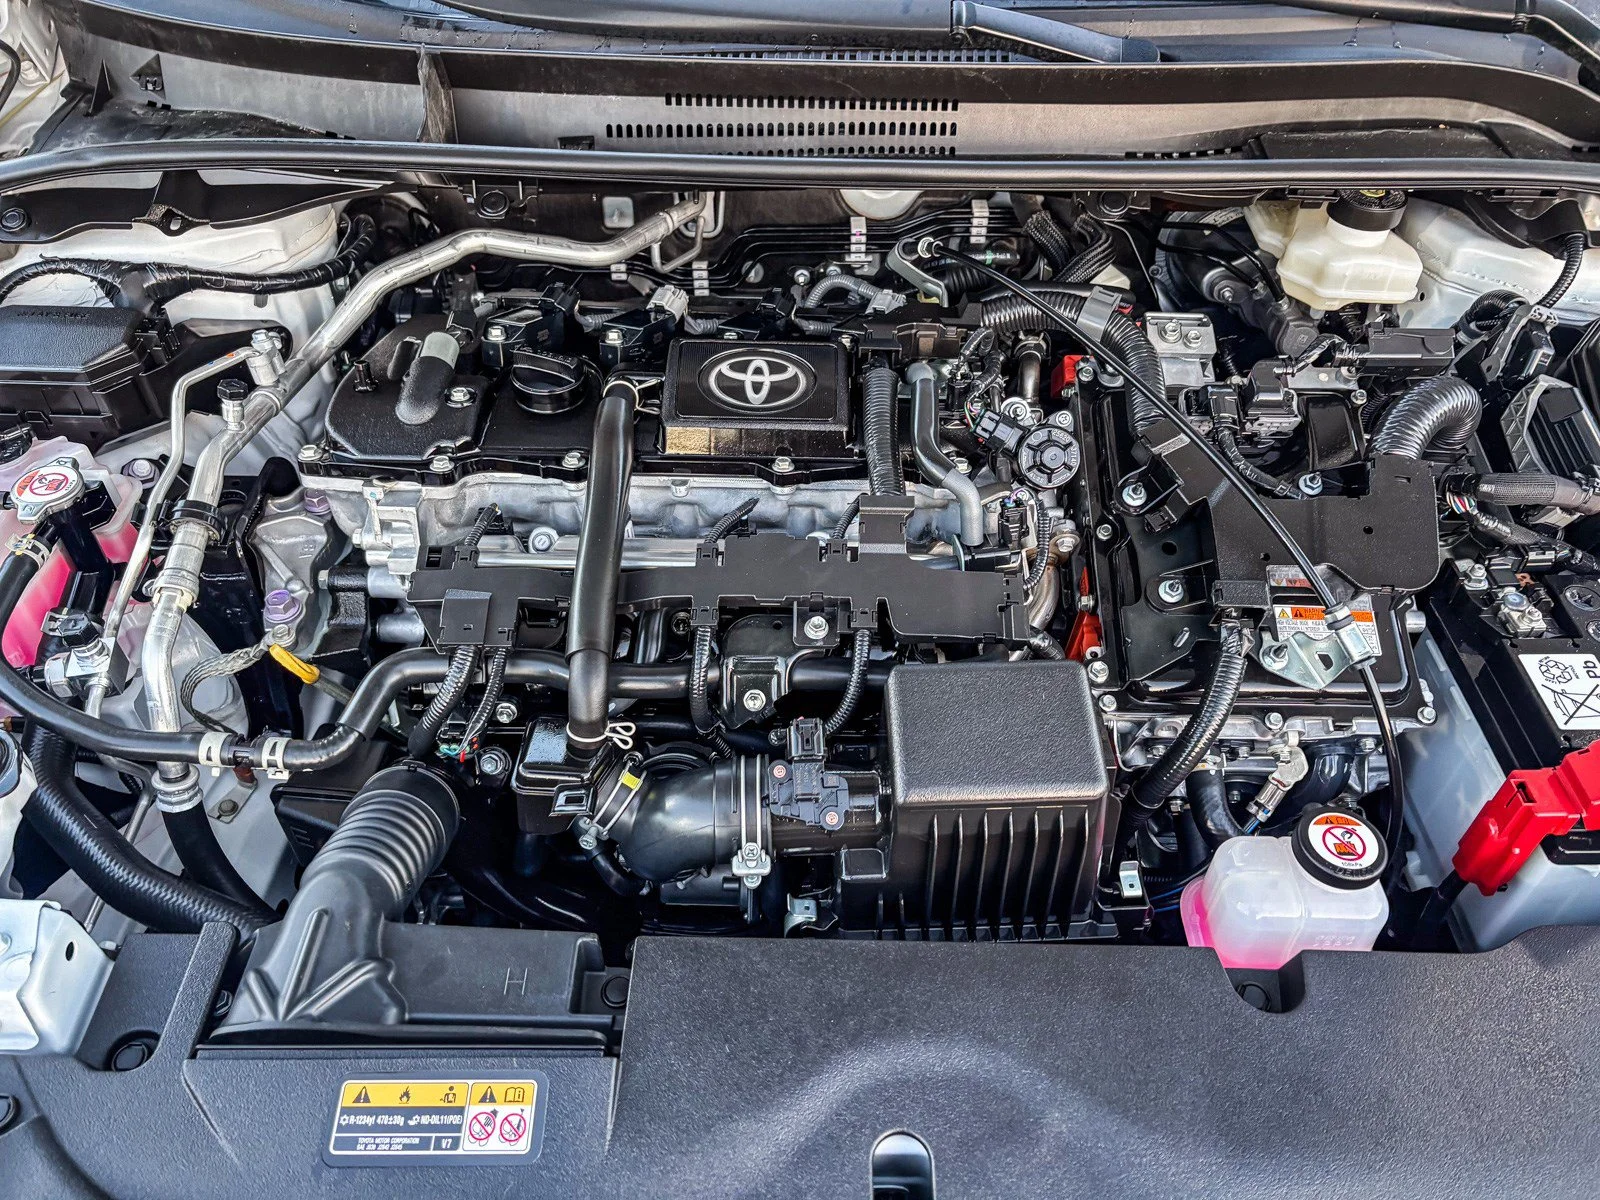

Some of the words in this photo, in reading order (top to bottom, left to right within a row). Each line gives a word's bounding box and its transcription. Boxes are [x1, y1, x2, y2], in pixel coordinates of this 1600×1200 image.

[1583, 660, 1600, 679] Pb
[503, 967, 528, 995] H
[349, 1115, 375, 1126] R-1234yf
[441, 1138, 453, 1149] V7
